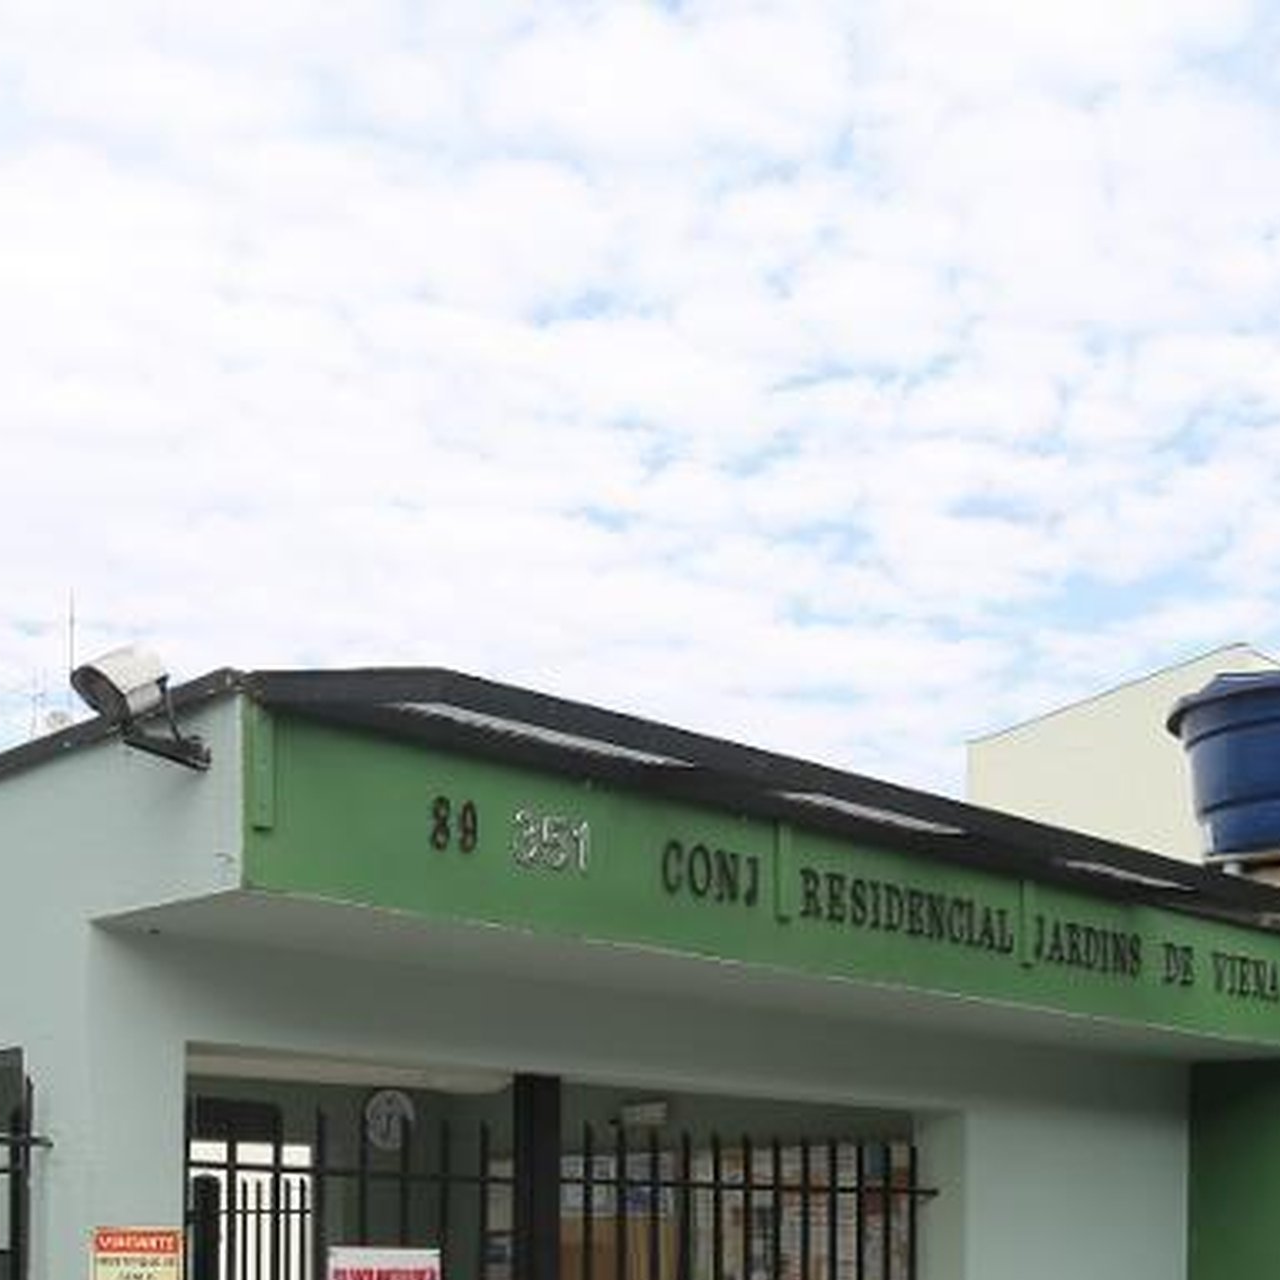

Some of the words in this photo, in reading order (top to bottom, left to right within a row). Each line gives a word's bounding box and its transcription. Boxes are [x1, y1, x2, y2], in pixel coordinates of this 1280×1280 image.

[662, 839, 759, 906] CONJ
[799, 868, 1014, 953] RESIDENCIAL
[1034, 914, 1142, 978] JARDINS
[1161, 942, 1195, 986] DE
[1211, 951, 1280, 1004] VIENA
